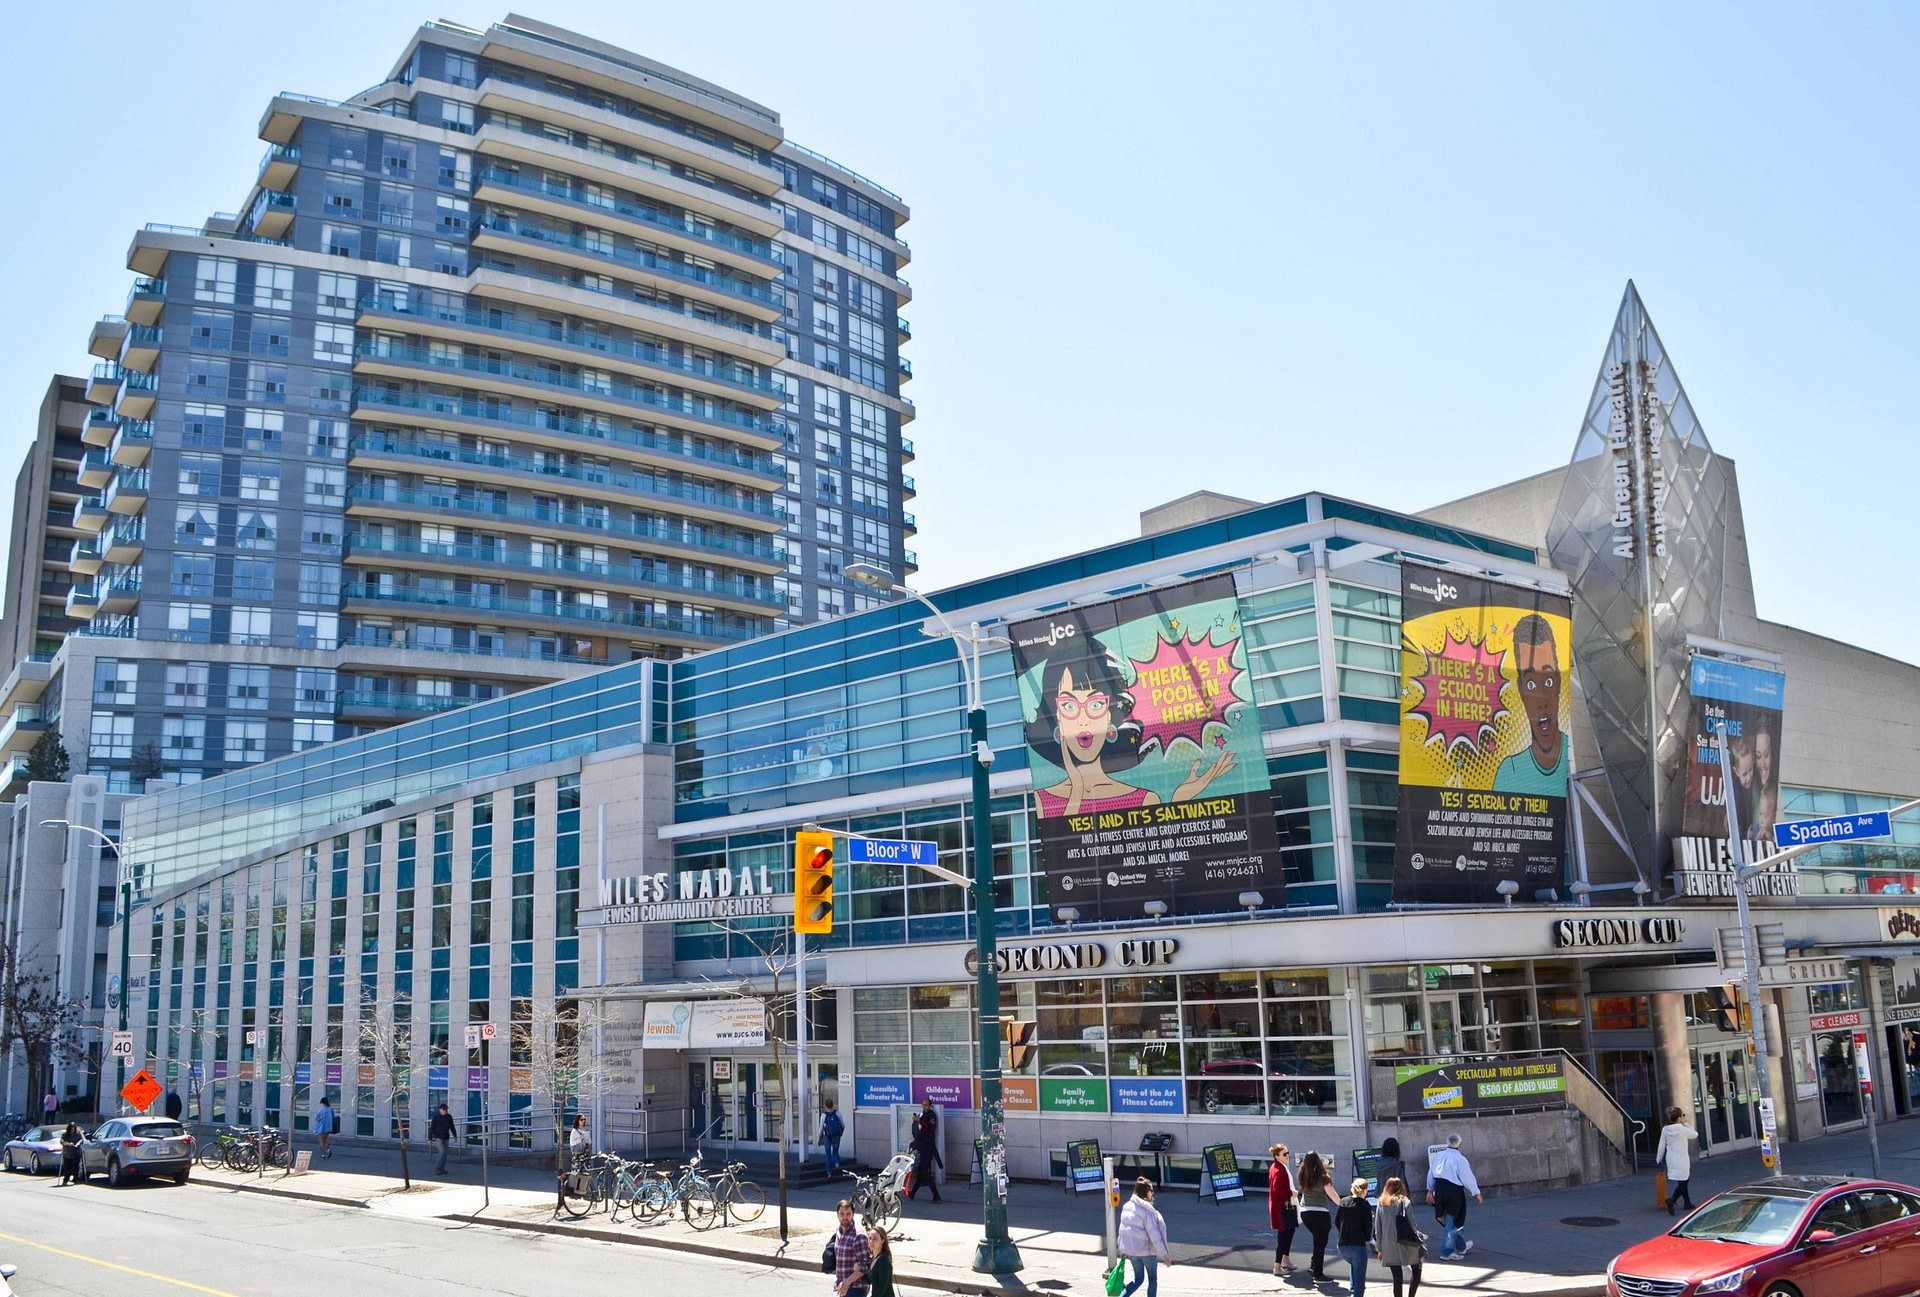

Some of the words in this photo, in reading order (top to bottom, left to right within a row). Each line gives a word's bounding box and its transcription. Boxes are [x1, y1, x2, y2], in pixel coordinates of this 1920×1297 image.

[1607, 362, 1628, 450] Theatre
[1649, 392, 1660, 459] Green
[1611, 460, 1631, 528] Green
[1653, 468, 1667, 557] Theatre
[1613, 535, 1633, 558] Al
[1410, 583, 1422, 591] Miles
[1435, 578, 1457, 601] jcc
[1019, 639, 1034, 647] Miles
[1034, 635, 1050, 644] Nadal
[1049, 622, 1075, 646] jcc
[1138, 659, 1211, 689] THERE'S
[1216, 657, 1228, 673] A
[1430, 658, 1484, 682] THERE'S
[1488, 666, 1495, 683] A
[1152, 685, 1197, 707] POOL
[1203, 678, 1220, 697] IN
[1438, 680, 1489, 701] SCHOOL
[1162, 701, 1213, 725] HERE?
[1437, 700, 1450, 717] IN
[1454, 701, 1492, 722] HERE?
[1705, 704, 1714, 716] Be
[1715, 706, 1724, 717] the
[1697, 734, 1708, 747] See
[1709, 736, 1720, 748] the
[1698, 748, 1731, 764] IMPA
[1440, 792, 1463, 807] YES!
[1468, 793, 1507, 810] SEVERAL
[1510, 797, 1521, 811] OF
[1525, 798, 1548, 813] THEM!
[1069, 817, 1093, 832] YES!
[1100, 813, 1123, 829] AND
[1128, 810, 1151, 825] IT'S
[1157, 799, 1235, 822] SALTWATER!
[1428, 810, 1439, 821] AND
[1441, 811, 1458, 822] CAMPS
[1459, 812, 1469, 822] AND
[1470, 813, 1494, 824] SWIMMING
[1495, 814, 1512, 825] LESSONS
[1513, 815, 1522, 826] AND
[1522, 816, 1536, 827] JUNGLE
[1537, 817, 1546, 827] GYM
[1082, 834, 1093, 844] AND
[1094, 833, 1099, 843] A
[1100, 830, 1121, 842] FITNESS
[1123, 828, 1143, 840] CENTRE
[1145, 826, 1158, 837] AND
[1160, 823, 1180, 835] GROUP
[1182, 820, 1210, 833] EXERCISE
[1212, 819, 1225, 830] AND
[1427, 825, 1448, 836] SUZUKI
[1448, 826, 1464, 837] MUSIC
[1465, 827, 1475, 837] AND
[1476, 828, 1492, 838] JEWISH
[1493, 829, 1501, 838] LIFE
[1502, 829, 1511, 839] AND
[1512, 830, 1533, 840] ACCESSIBLE
[1534, 831, 1552, 841] PROGRAMS
[1790, 820, 1853, 843] Spadina
[1858, 817, 1873, 826] Ave
[866, 841, 899, 858] Bloor
[901, 844, 907, 852] St
[911, 844, 921, 859] W
[1067, 849, 1080, 858] ARTS
[1081, 848, 1086, 856] &
[1087, 845, 1110, 857] CULTURE
[1112, 843, 1124, 854] AND
[1125, 840, 1146, 852] JEWISH
[1148, 839, 1160, 850] LIFE
[1161, 837, 1175, 848] AND
[1176, 834, 1211, 847] ACCESSIBLE
[1212, 830, 1247, 844] PROGRAMS
[1473, 842, 1483, 851] AND
[1492, 843, 1506, 852] MUCH.
[1507, 844, 1520, 853] MORE!
[1123, 857, 1135, 867] AND
[1137, 856, 1147, 865] SO.
[1148, 853, 1167, 864] MUCH.
[1169, 851, 1189, 862] MORE!
[1206, 855, 1262, 868] www.mnjcc.org
[1205, 868, 1225, 880] (416)
[1227, 865, 1264, 878] 924-6211
[600, 872, 668, 906] MILES
[680, 865, 775, 900] NADAL
[1687, 874, 1719, 896] JEWISH
[1721, 874, 1769, 896] COUNITY
[600, 907, 638, 924] JEWISH
[641, 901, 714, 922] COMMUNITY
[719, 897, 771, 916] CENTRE
[1560, 919, 1640, 947] SECOND
[1648, 918, 1686, 943] CUP
[997, 943, 1104, 974] SECOND
[1115, 938, 1177, 966] CUP
[1811, 1018, 1825, 1028] NICE
[1827, 1014, 1858, 1027] CLEANERS
[1897, 1007, 1920, 1020] FRENCH
[647, 1021, 675, 1035] Jewish
[114, 1042, 131, 1053] 40
[1456, 1068, 1496, 1080] SPECTACULAR
[1499, 1068, 1512, 1077] TWO
[1513, 1066, 1523, 1076] DAY
[1527, 1065, 1545, 1075] FITNESS
[1545, 1063, 1557, 1073] SALE
[124, 1087, 158, 1095] CONSTRUCTION
[870, 1085, 898, 1093] Accessible
[1063, 1088, 1085, 1097] Family
[1480, 1083, 1501, 1096] $500
[1503, 1083, 1512, 1093] OF
[1514, 1081, 1536, 1092] ADDED
[1538, 1080, 1558, 1090] VALUE!
[1009, 1096, 1032, 1104] Classes
[1055, 1097, 1077, 1106] Jungle
[1078, 1098, 1095, 1106] Gym
[1080, 1157, 1099, 1167] SALE
[1217, 1162, 1237, 1173] SALE
